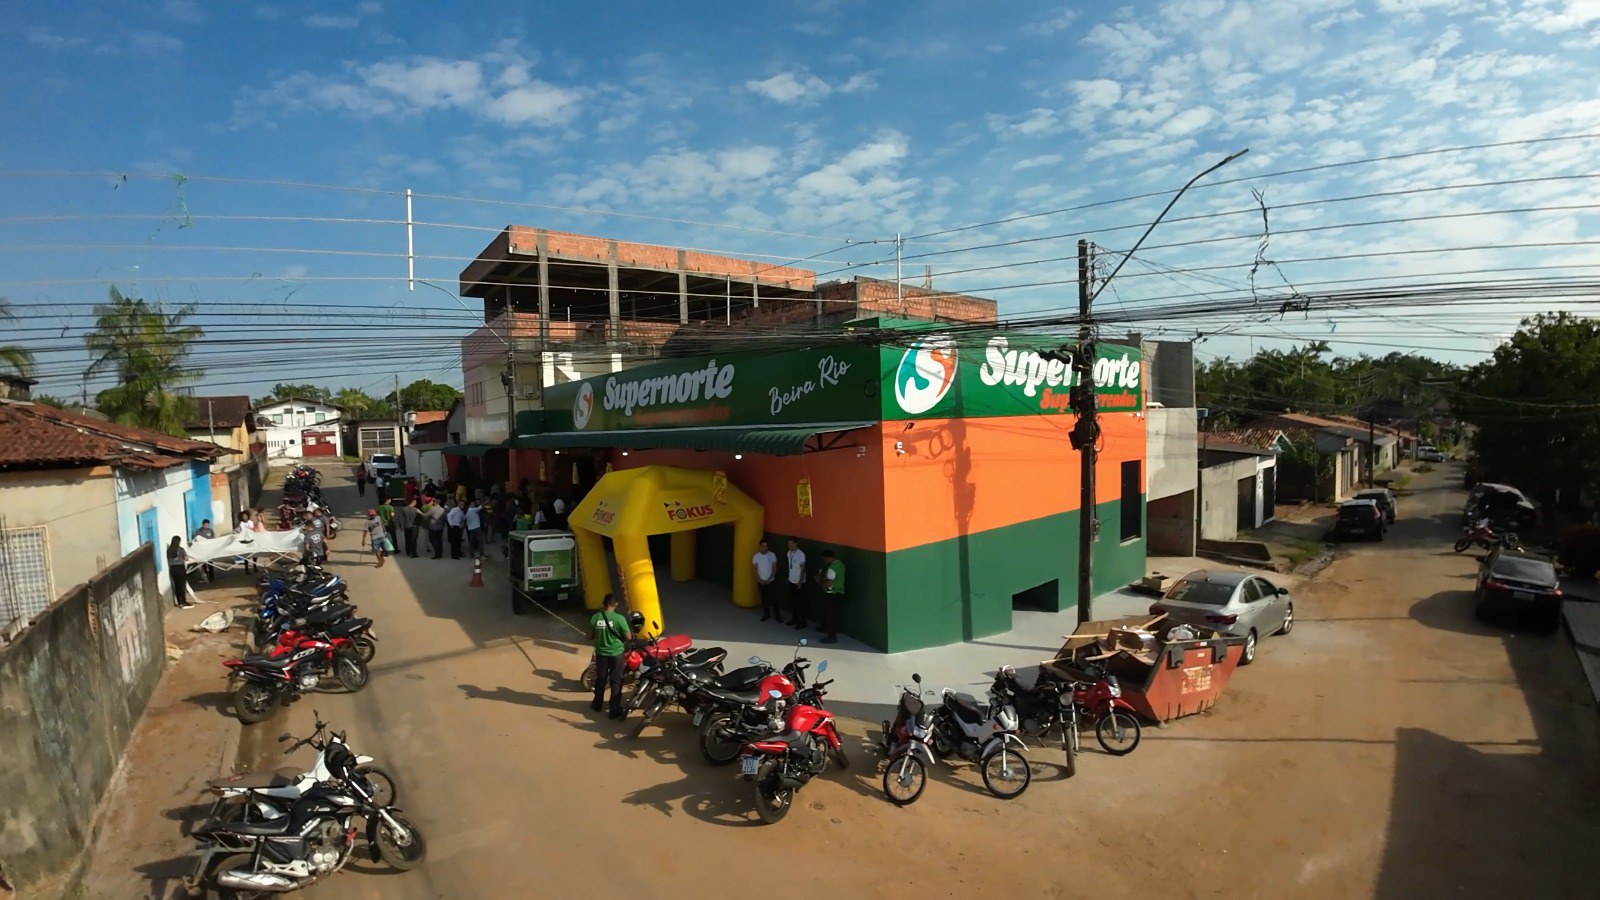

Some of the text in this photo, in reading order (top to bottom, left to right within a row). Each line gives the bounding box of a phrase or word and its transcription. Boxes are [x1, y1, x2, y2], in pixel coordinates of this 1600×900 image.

[603, 359, 735, 416] Supernorte
[768, 379, 816, 416] Beira
[817, 355, 852, 386] Rio
[667, 504, 714, 521] FOKUS
